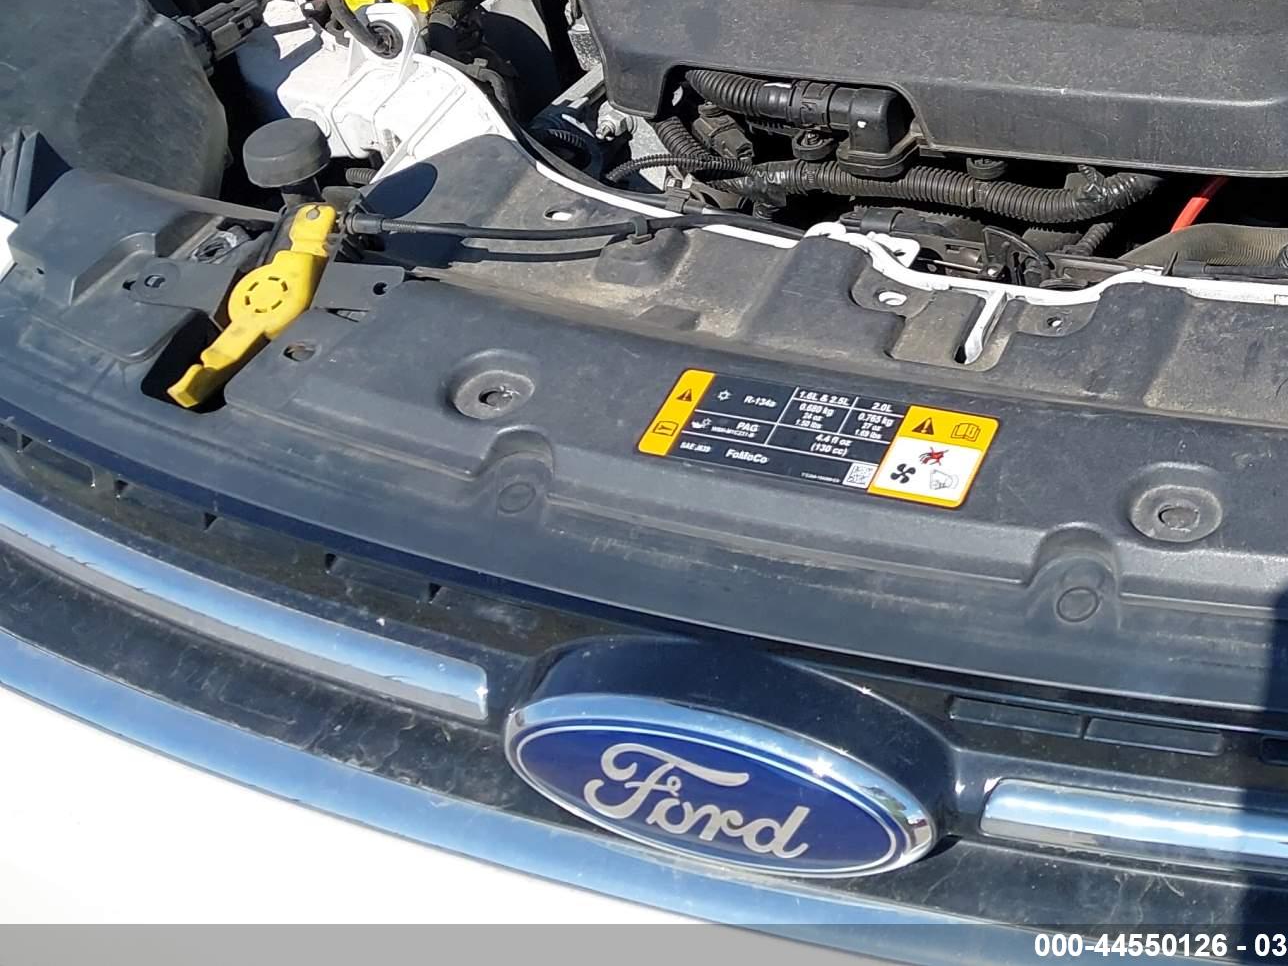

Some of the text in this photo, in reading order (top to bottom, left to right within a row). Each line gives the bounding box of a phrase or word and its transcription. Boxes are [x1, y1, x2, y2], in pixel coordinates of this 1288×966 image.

[820, 394, 829, 403] &
[871, 402, 893, 413] 2.0L
[736, 421, 760, 433] PAG
[725, 448, 769, 464] FoMoCo
[583, 742, 812, 859] Ford
